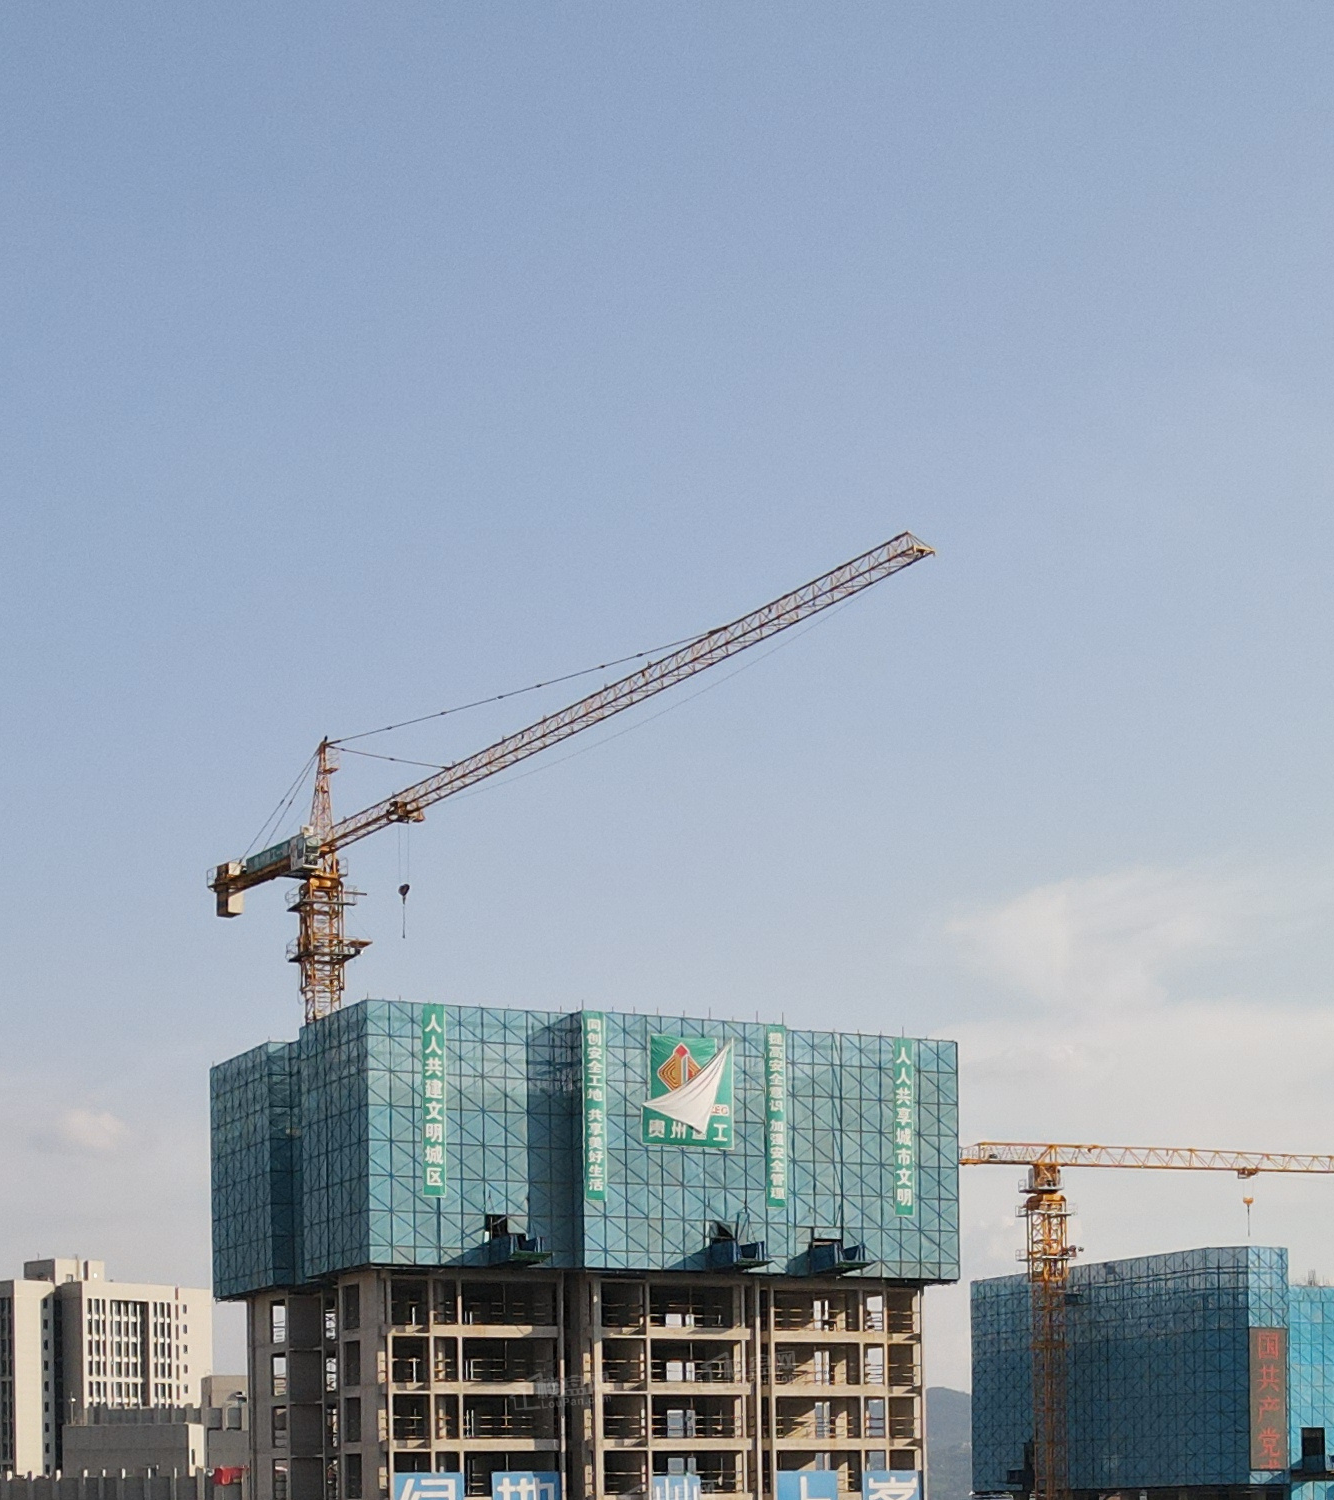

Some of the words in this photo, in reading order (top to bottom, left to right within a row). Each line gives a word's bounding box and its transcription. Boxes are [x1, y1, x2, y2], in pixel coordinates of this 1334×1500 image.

[424, 1012, 444, 1188] 人人共建文明城区
[588, 1107, 605, 1193] 共享美好生活
[895, 1045, 913, 1209] 人人共享城市文明
